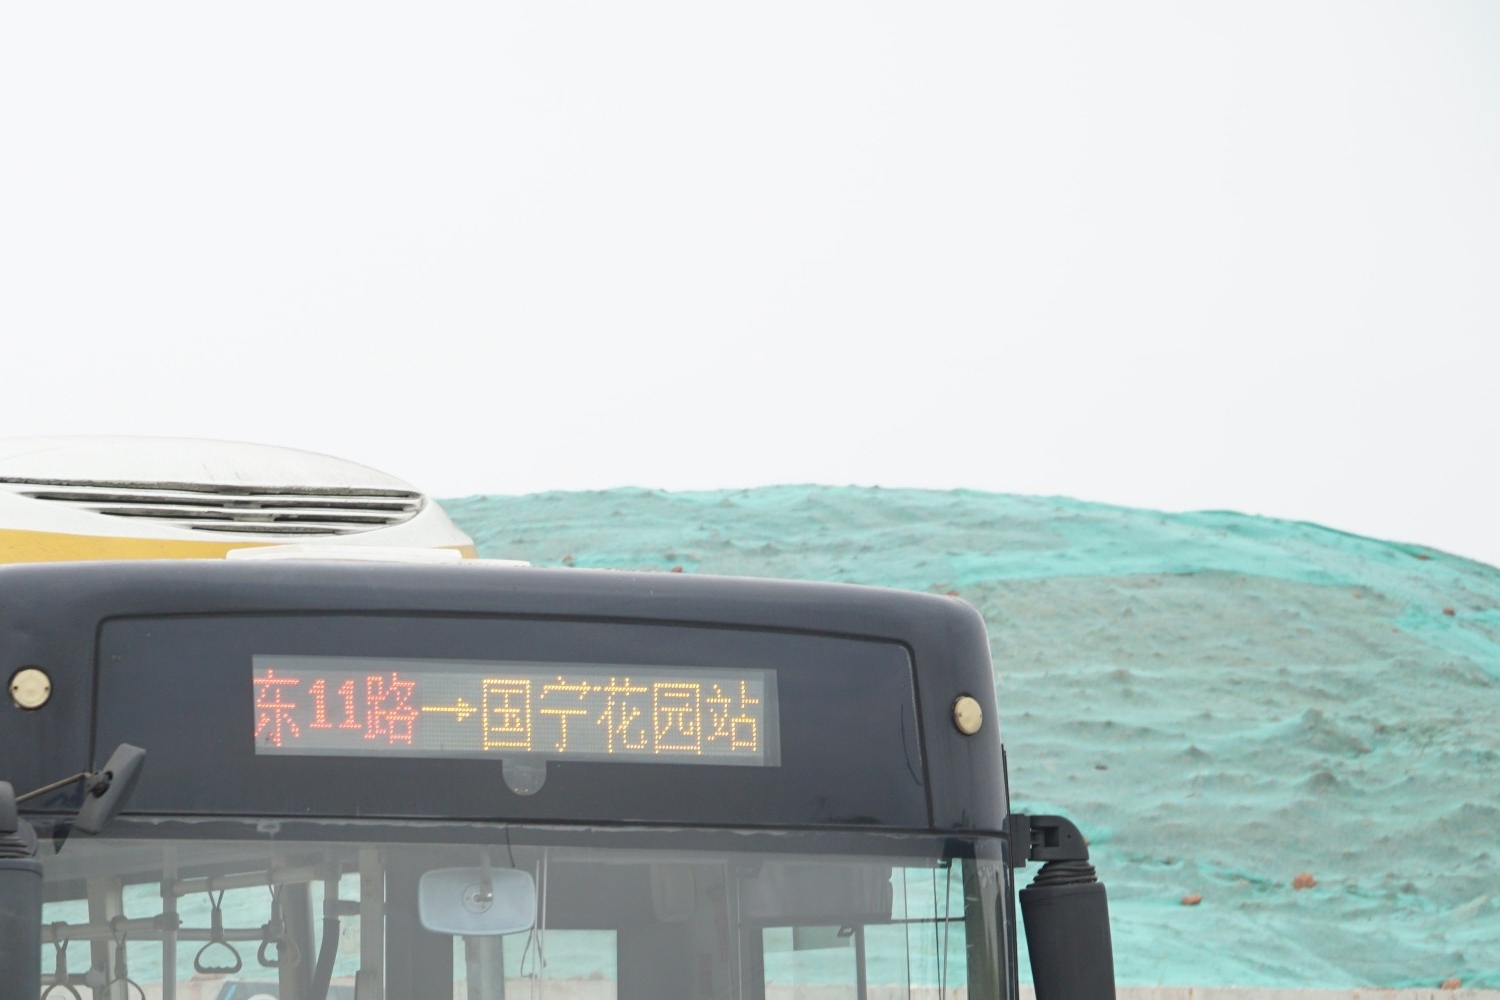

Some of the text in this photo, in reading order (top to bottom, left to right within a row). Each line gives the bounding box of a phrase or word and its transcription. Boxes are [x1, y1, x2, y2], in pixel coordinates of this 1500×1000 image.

[482, 675, 760, 754] 国宁花园站
